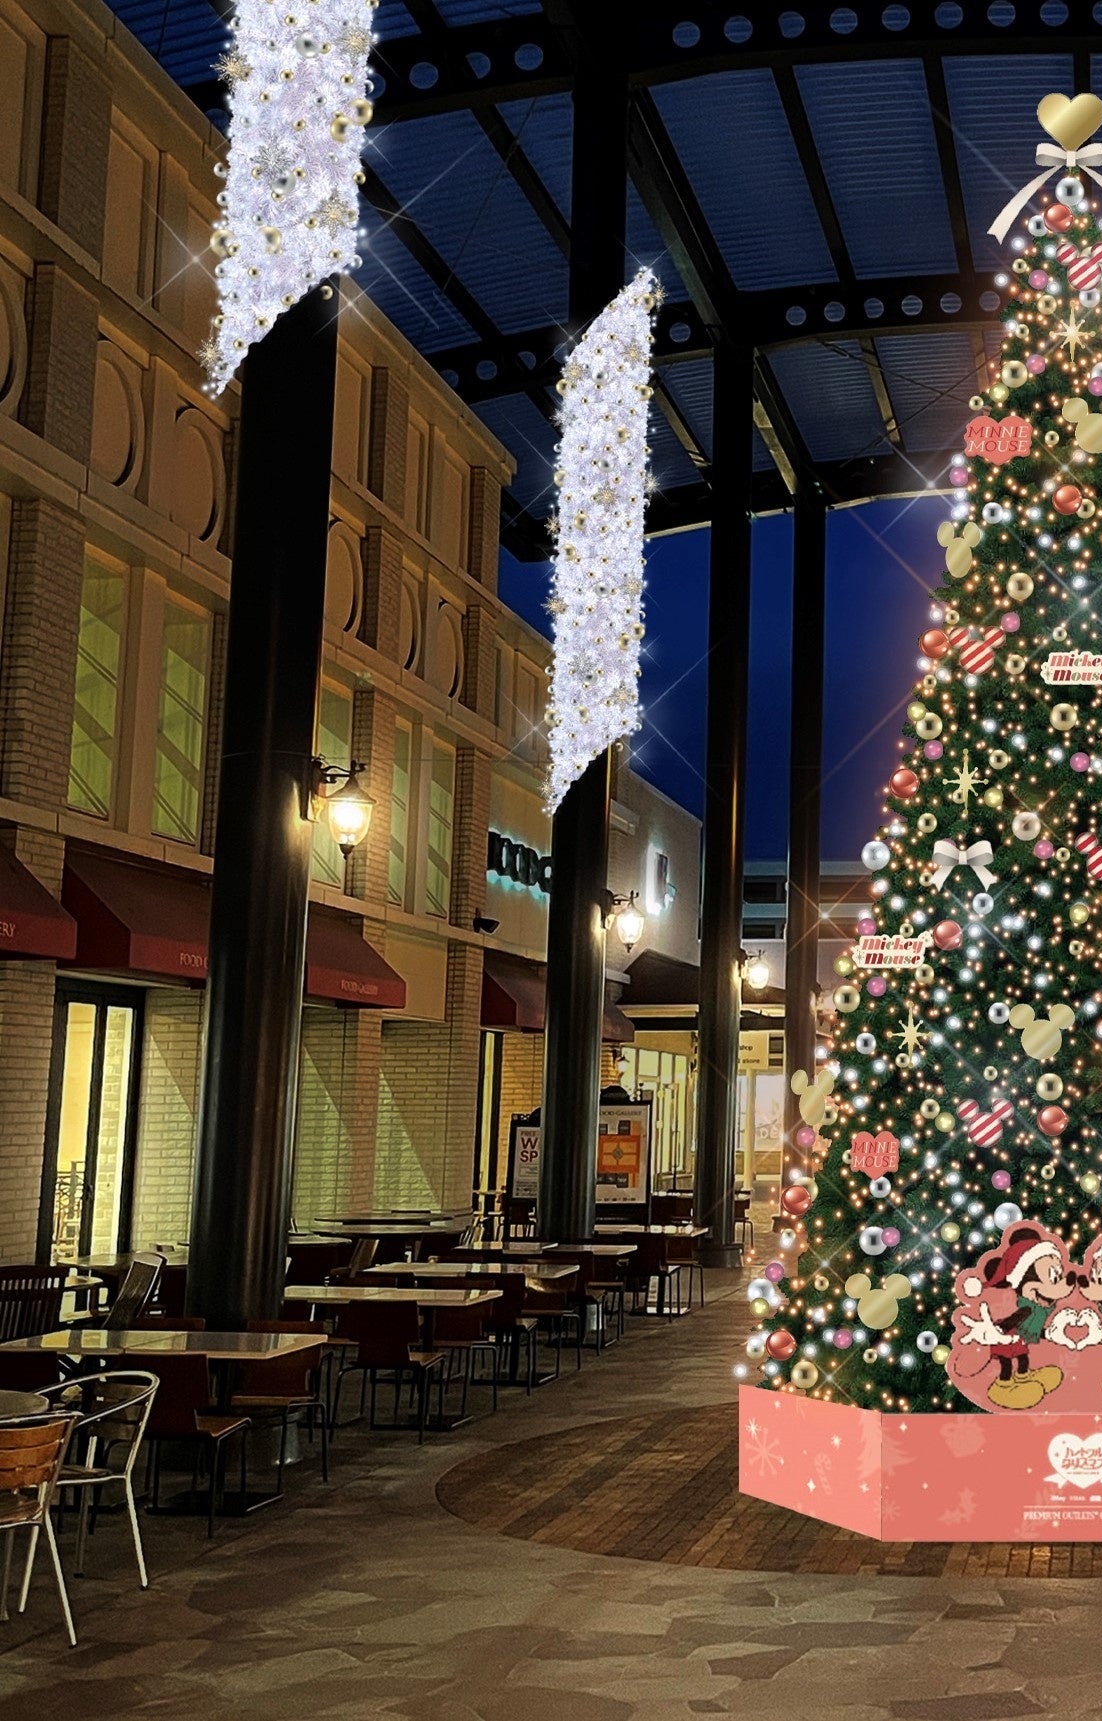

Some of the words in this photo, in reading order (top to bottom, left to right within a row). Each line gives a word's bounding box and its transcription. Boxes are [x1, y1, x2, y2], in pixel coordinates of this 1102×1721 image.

[968, 426, 1029, 438] MINNIE
[968, 440, 1028, 452] MOUSE
[852, 1141, 898, 1153] MINNIE
[520, 1150, 539, 1163] SP
[853, 1155, 896, 1168] MOUSE
